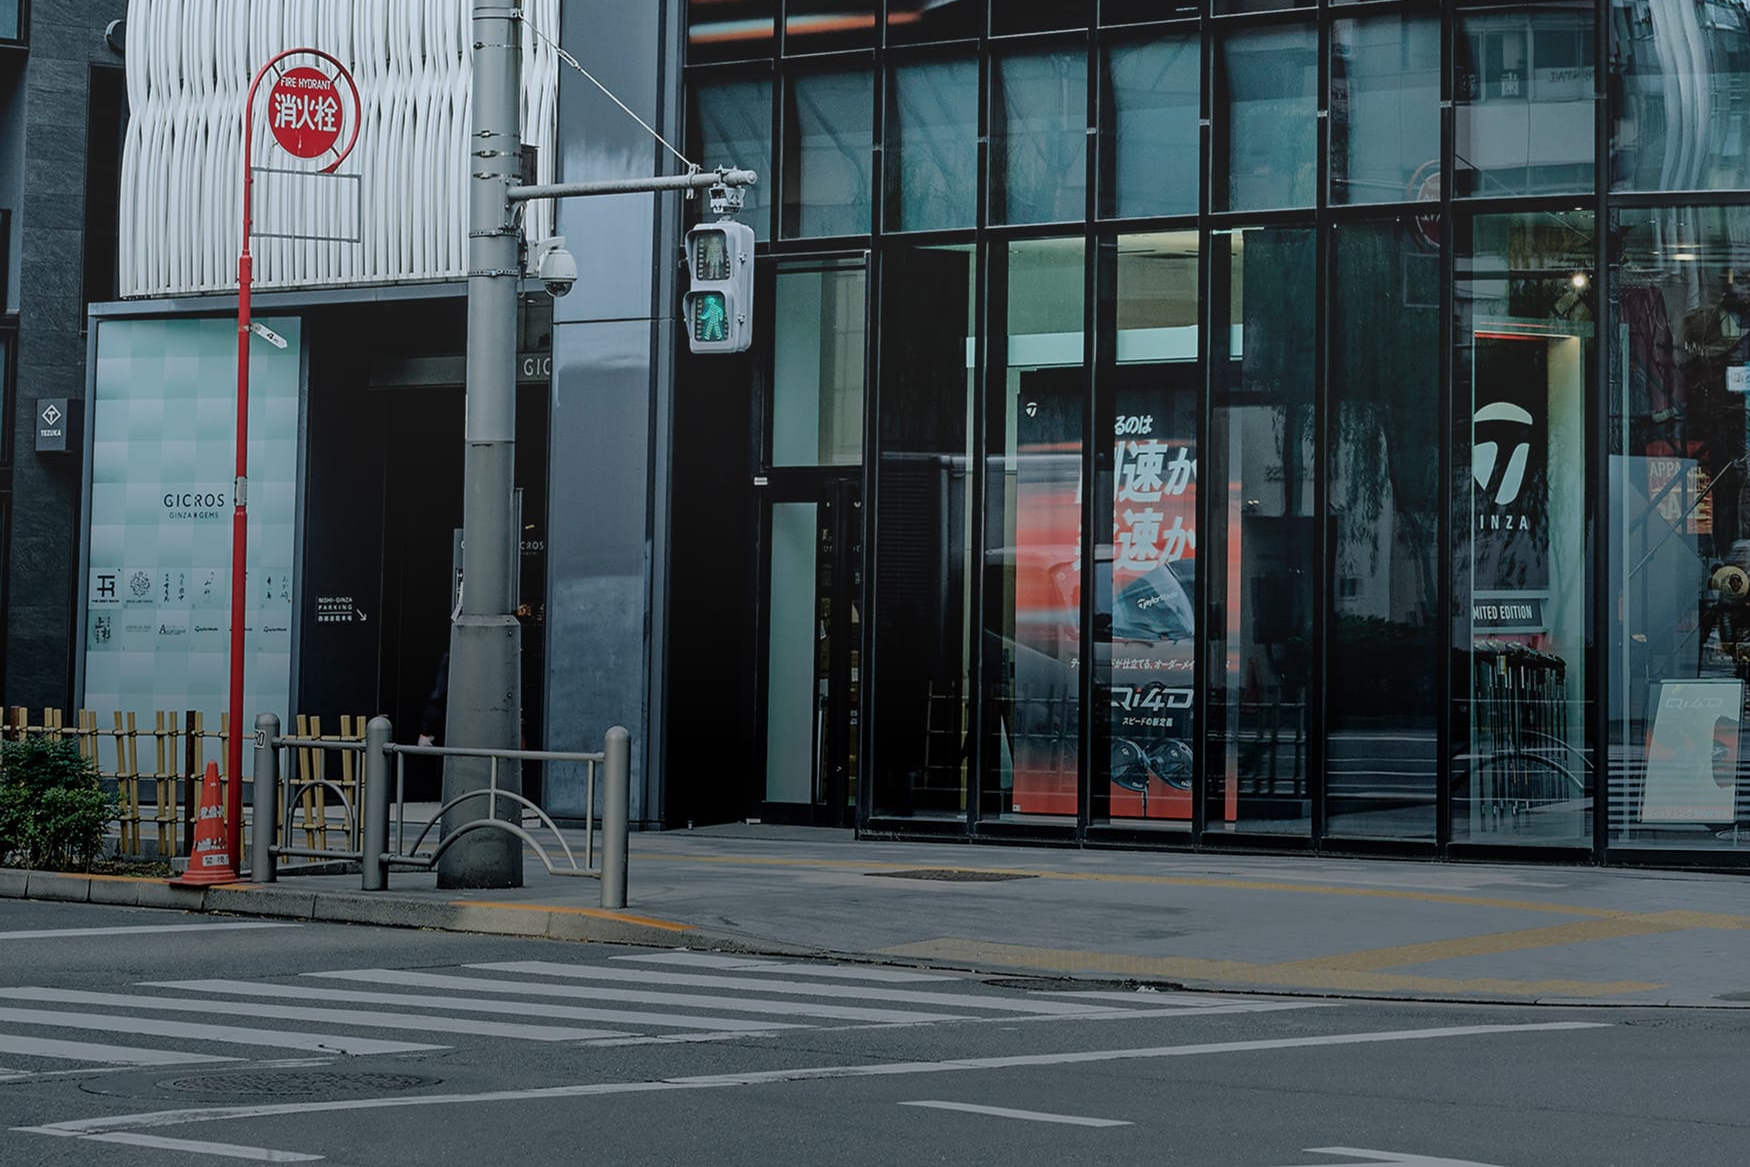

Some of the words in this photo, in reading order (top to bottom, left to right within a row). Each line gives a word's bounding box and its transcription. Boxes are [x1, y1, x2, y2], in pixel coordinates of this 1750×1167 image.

[281, 77, 297, 88] FIRE
[299, 78, 331, 91] HYDRANT
[274, 92, 338, 133] 消火栓
[523, 358, 550, 377] GIC
[1114, 414, 1153, 435] るのは
[1110, 439, 1197, 502] 速か
[163, 493, 226, 508] GICROS
[1479, 514, 1529, 530] INZA
[519, 540, 545, 551] CROS
[1108, 507, 1196, 571] 速か
[1473, 605, 1498, 620] MITED
[1500, 605, 1533, 620] EDITION
[1111, 686, 1195, 711] Qi4D
